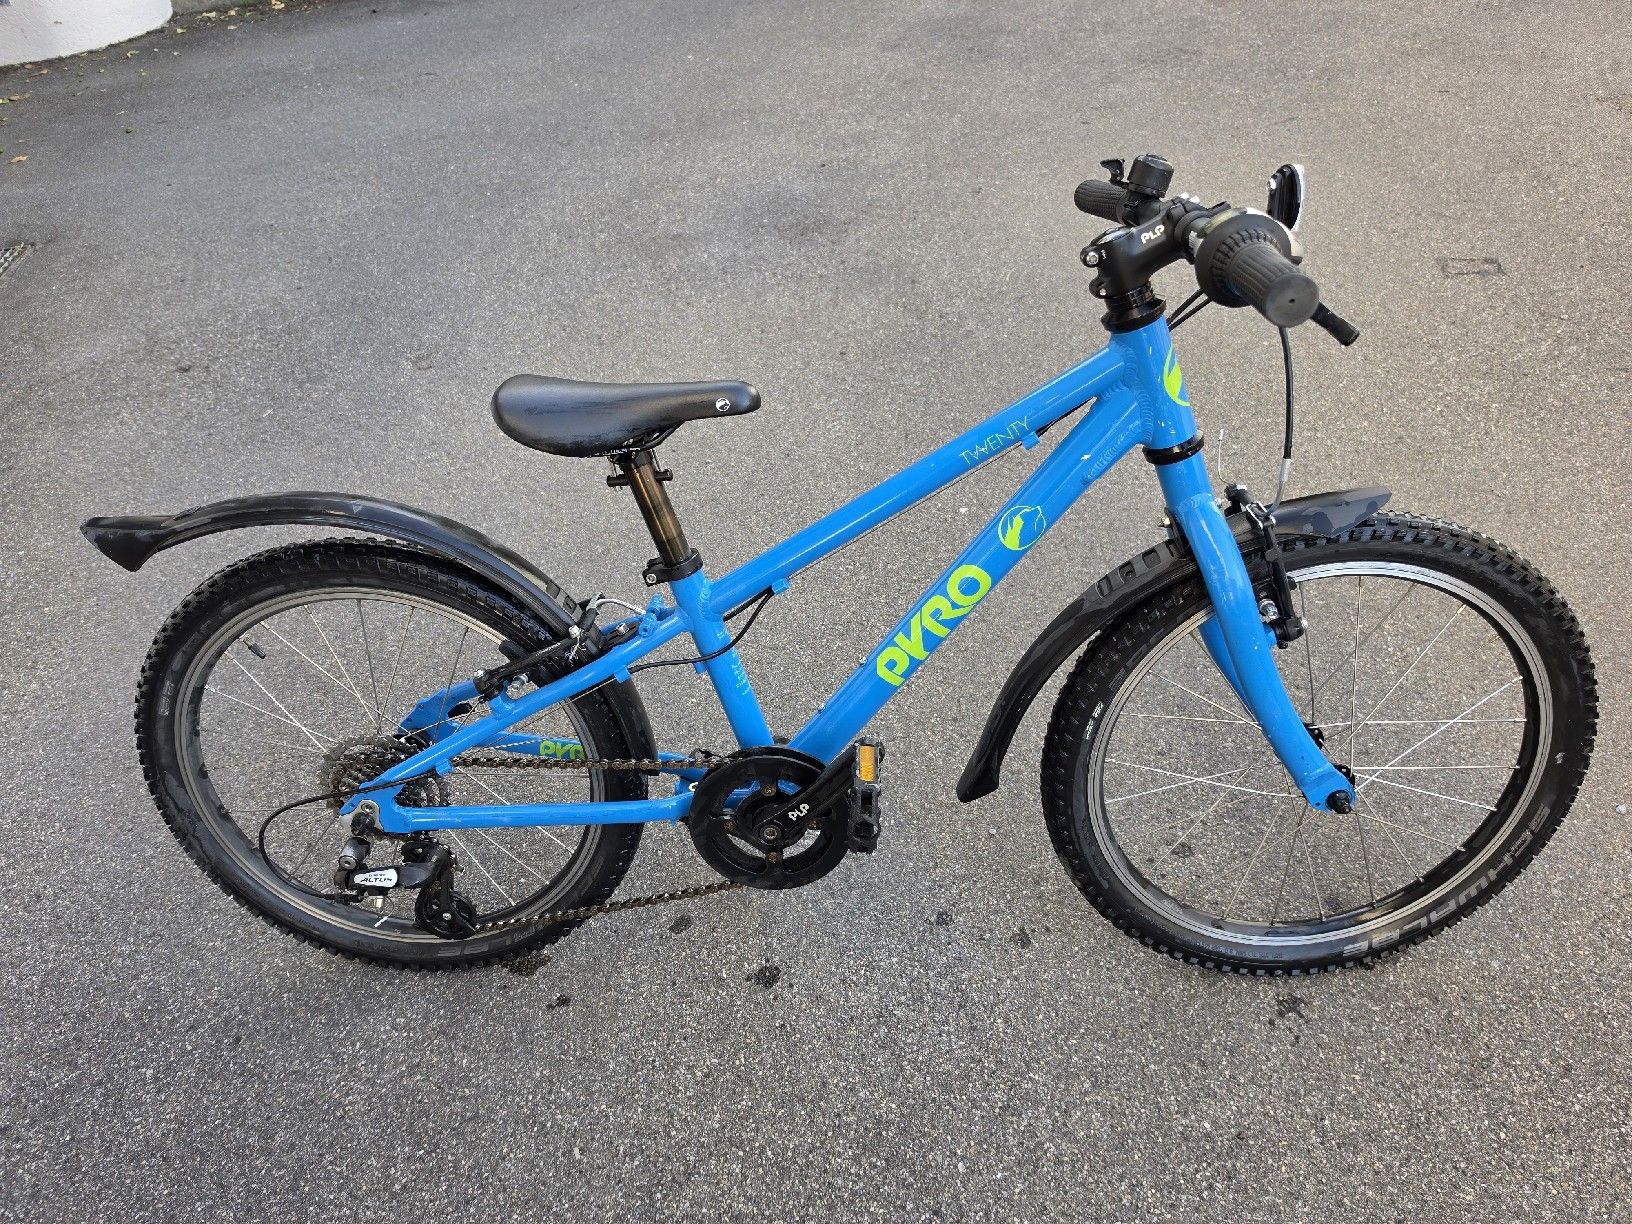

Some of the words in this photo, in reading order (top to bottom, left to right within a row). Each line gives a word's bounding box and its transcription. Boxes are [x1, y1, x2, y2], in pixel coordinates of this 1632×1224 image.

[1140, 224, 1165, 244] PLP
[958, 415, 1031, 465] TWENTY
[876, 564, 992, 687] PYRO
[539, 740, 586, 761] PYR
[788, 803, 810, 821] PLP
[1342, 802, 1550, 957] SCHWALBE
